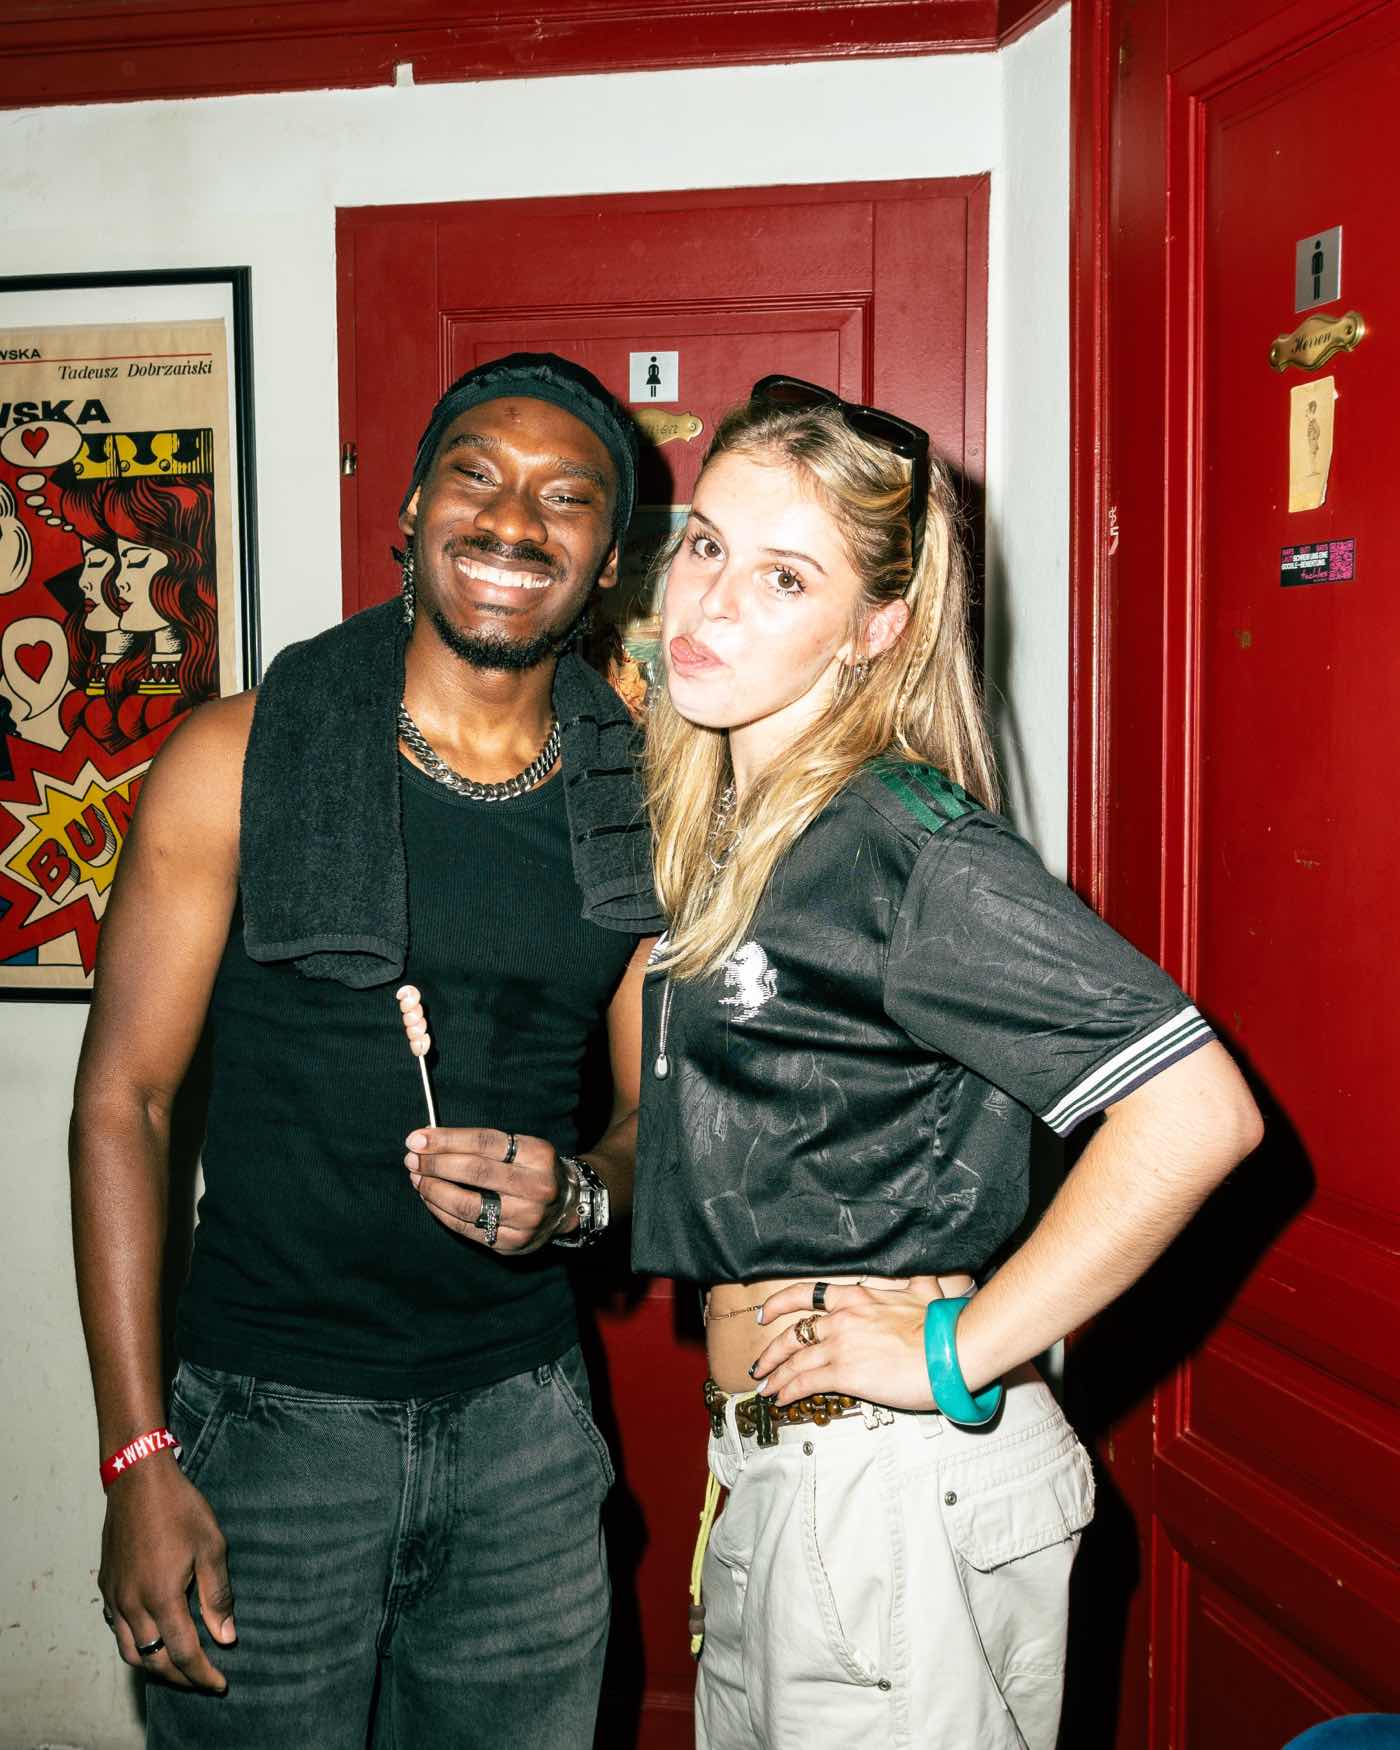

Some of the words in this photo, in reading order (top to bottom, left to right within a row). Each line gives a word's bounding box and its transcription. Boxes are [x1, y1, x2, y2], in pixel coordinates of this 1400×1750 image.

[58, 365, 120, 381] Tadeusz
[128, 360, 213, 378] Dobrzański
[122, 1431, 164, 1464] WHYZ
